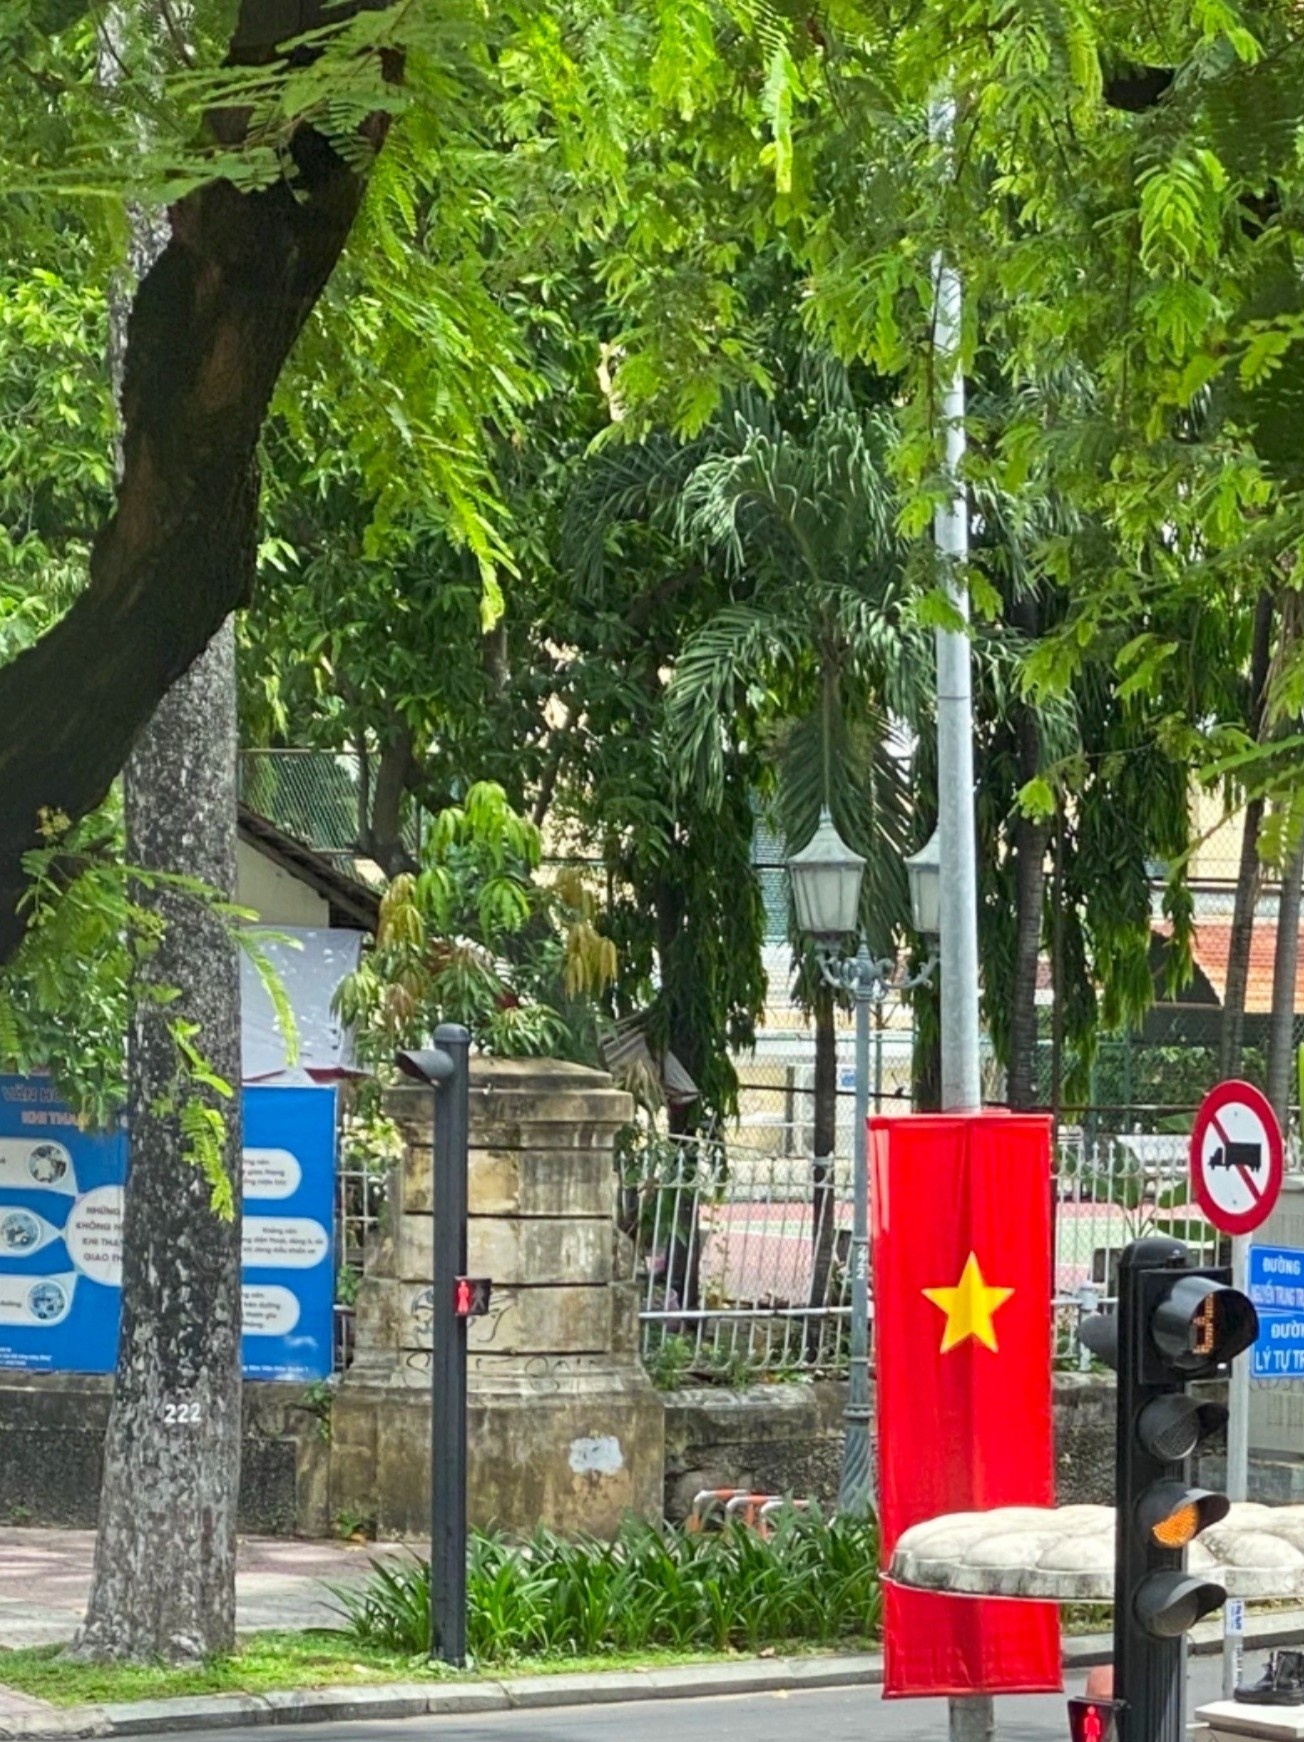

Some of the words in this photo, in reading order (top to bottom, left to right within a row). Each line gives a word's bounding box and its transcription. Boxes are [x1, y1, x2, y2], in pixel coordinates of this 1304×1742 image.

[1262, 1255, 1301, 1275] ĐƯỜNG
[1255, 1345, 1271, 1371] LÝ
[1273, 1348, 1292, 1373] TỰ
[163, 1402, 202, 1424] 222
